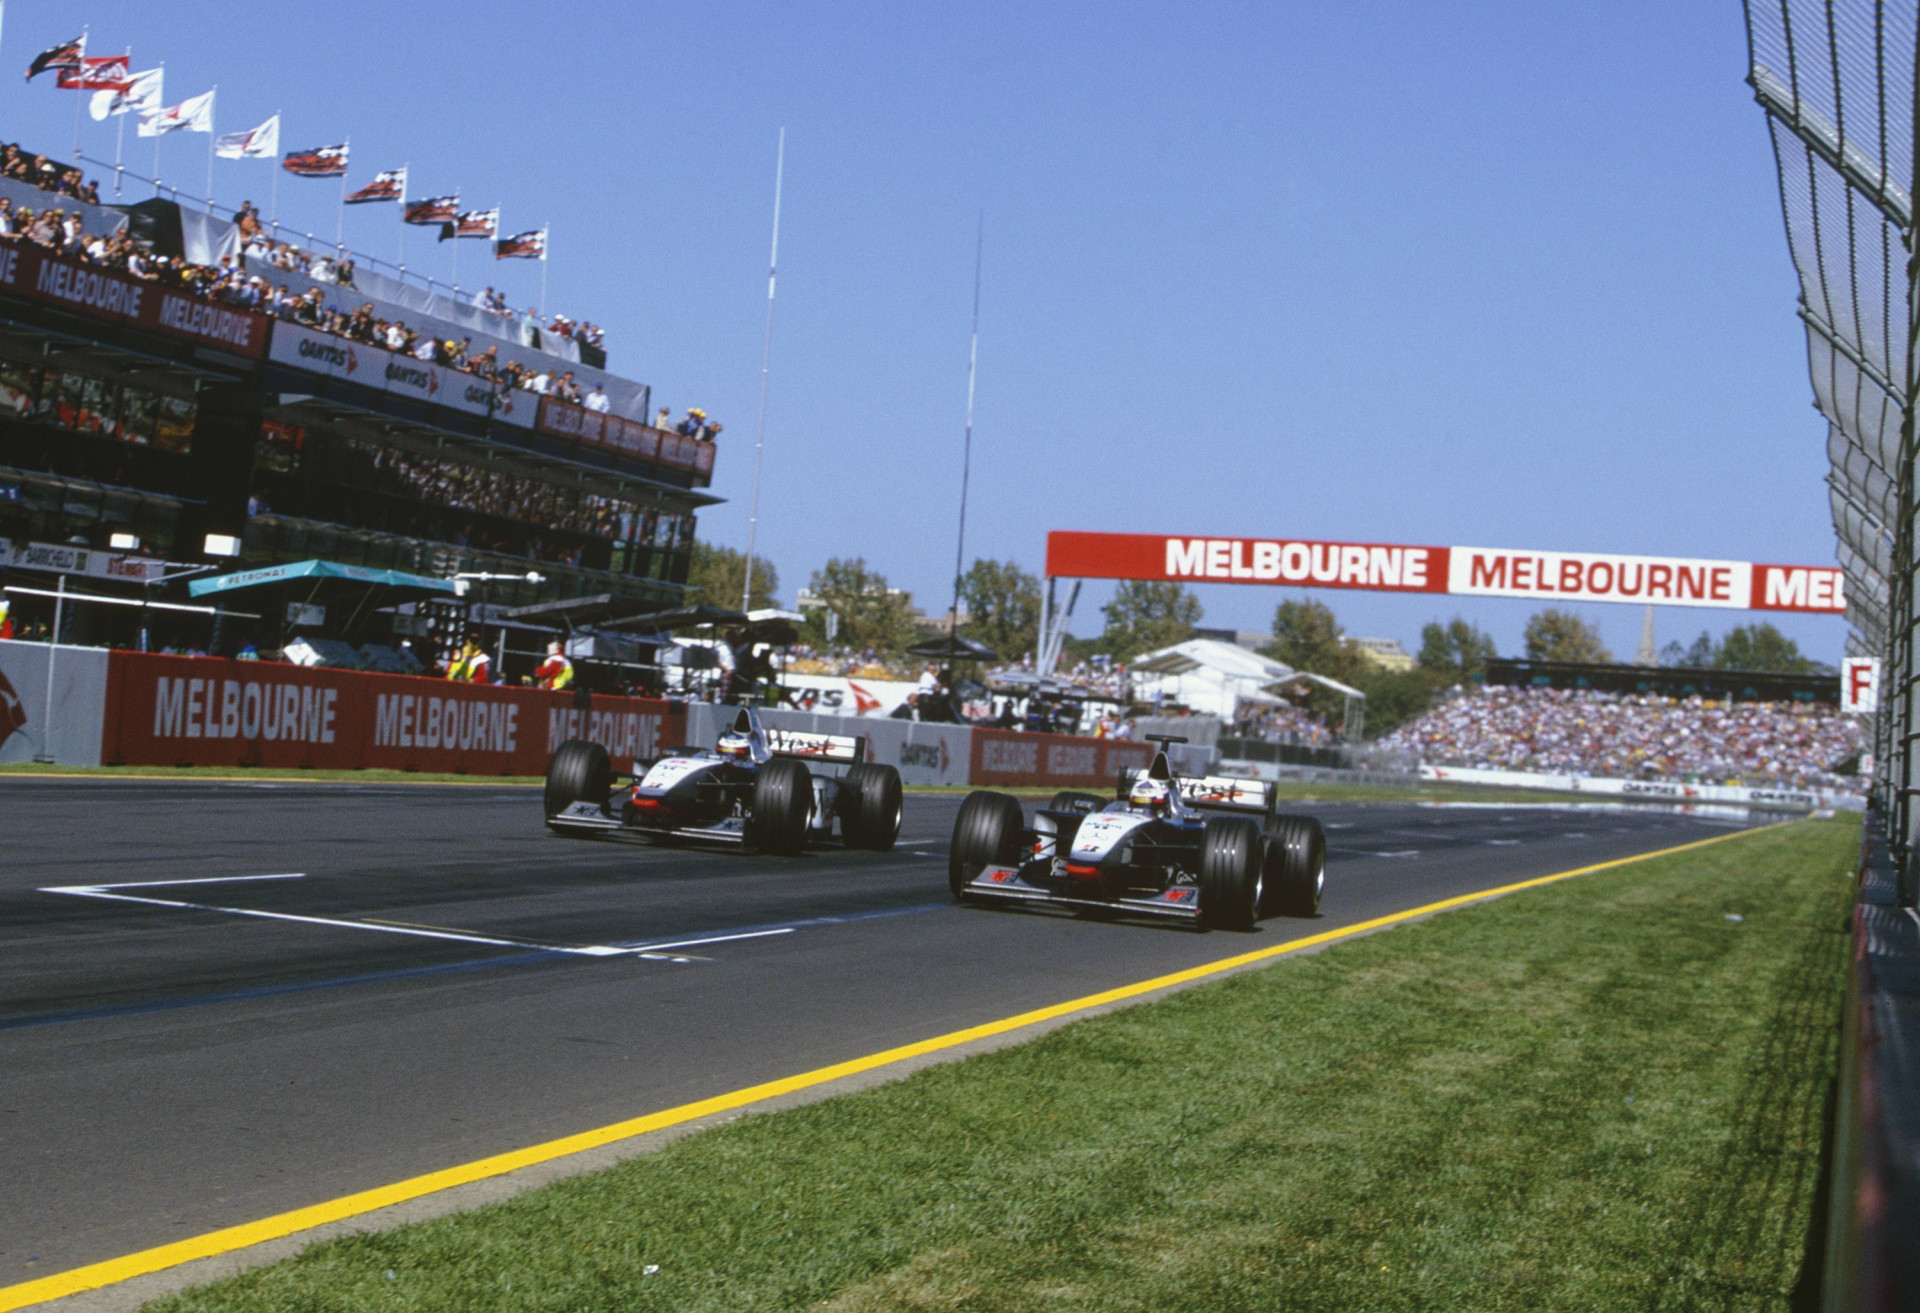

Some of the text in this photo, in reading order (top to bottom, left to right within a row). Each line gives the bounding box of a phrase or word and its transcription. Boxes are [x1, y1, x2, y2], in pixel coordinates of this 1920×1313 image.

[37, 258, 143, 318] MELBOURNE
[159, 294, 253, 347] MELBOURNE
[300, 338, 347, 367] QANTAS
[385, 362, 430, 389] QANTAS
[228, 567, 287, 586] PETRONAS
[1166, 538, 1429, 586] MELBOURNE
[1470, 554, 1732, 601] MELBOURNE
[1850, 665, 1872, 705] F
[153, 676, 339, 744] MELBOURNE
[373, 693, 520, 753] MELBOURNE
